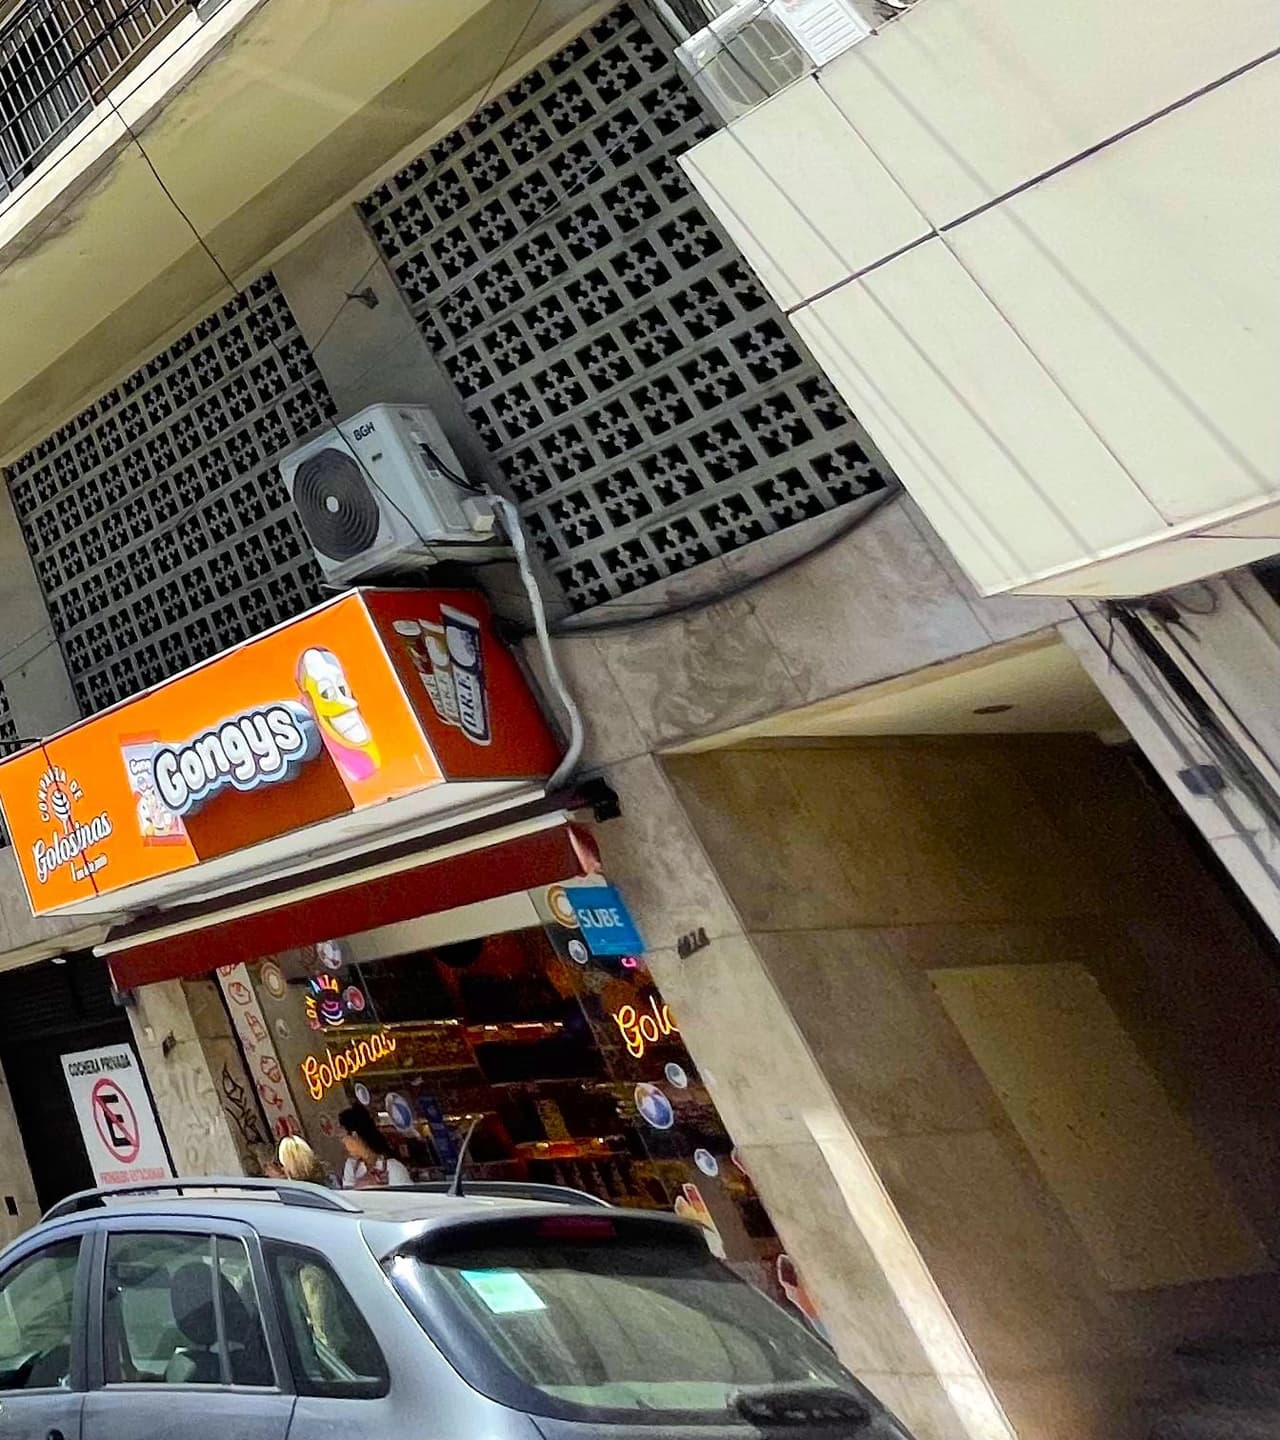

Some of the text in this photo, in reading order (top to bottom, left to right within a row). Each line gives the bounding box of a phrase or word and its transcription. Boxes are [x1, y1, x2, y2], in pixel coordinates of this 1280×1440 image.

[353, 421, 376, 442] BGH
[154, 706, 303, 810] Gongys
[69, 778, 84, 802] DE
[32, 811, 113, 883] Golosinas
[578, 907, 625, 928] SUBE
